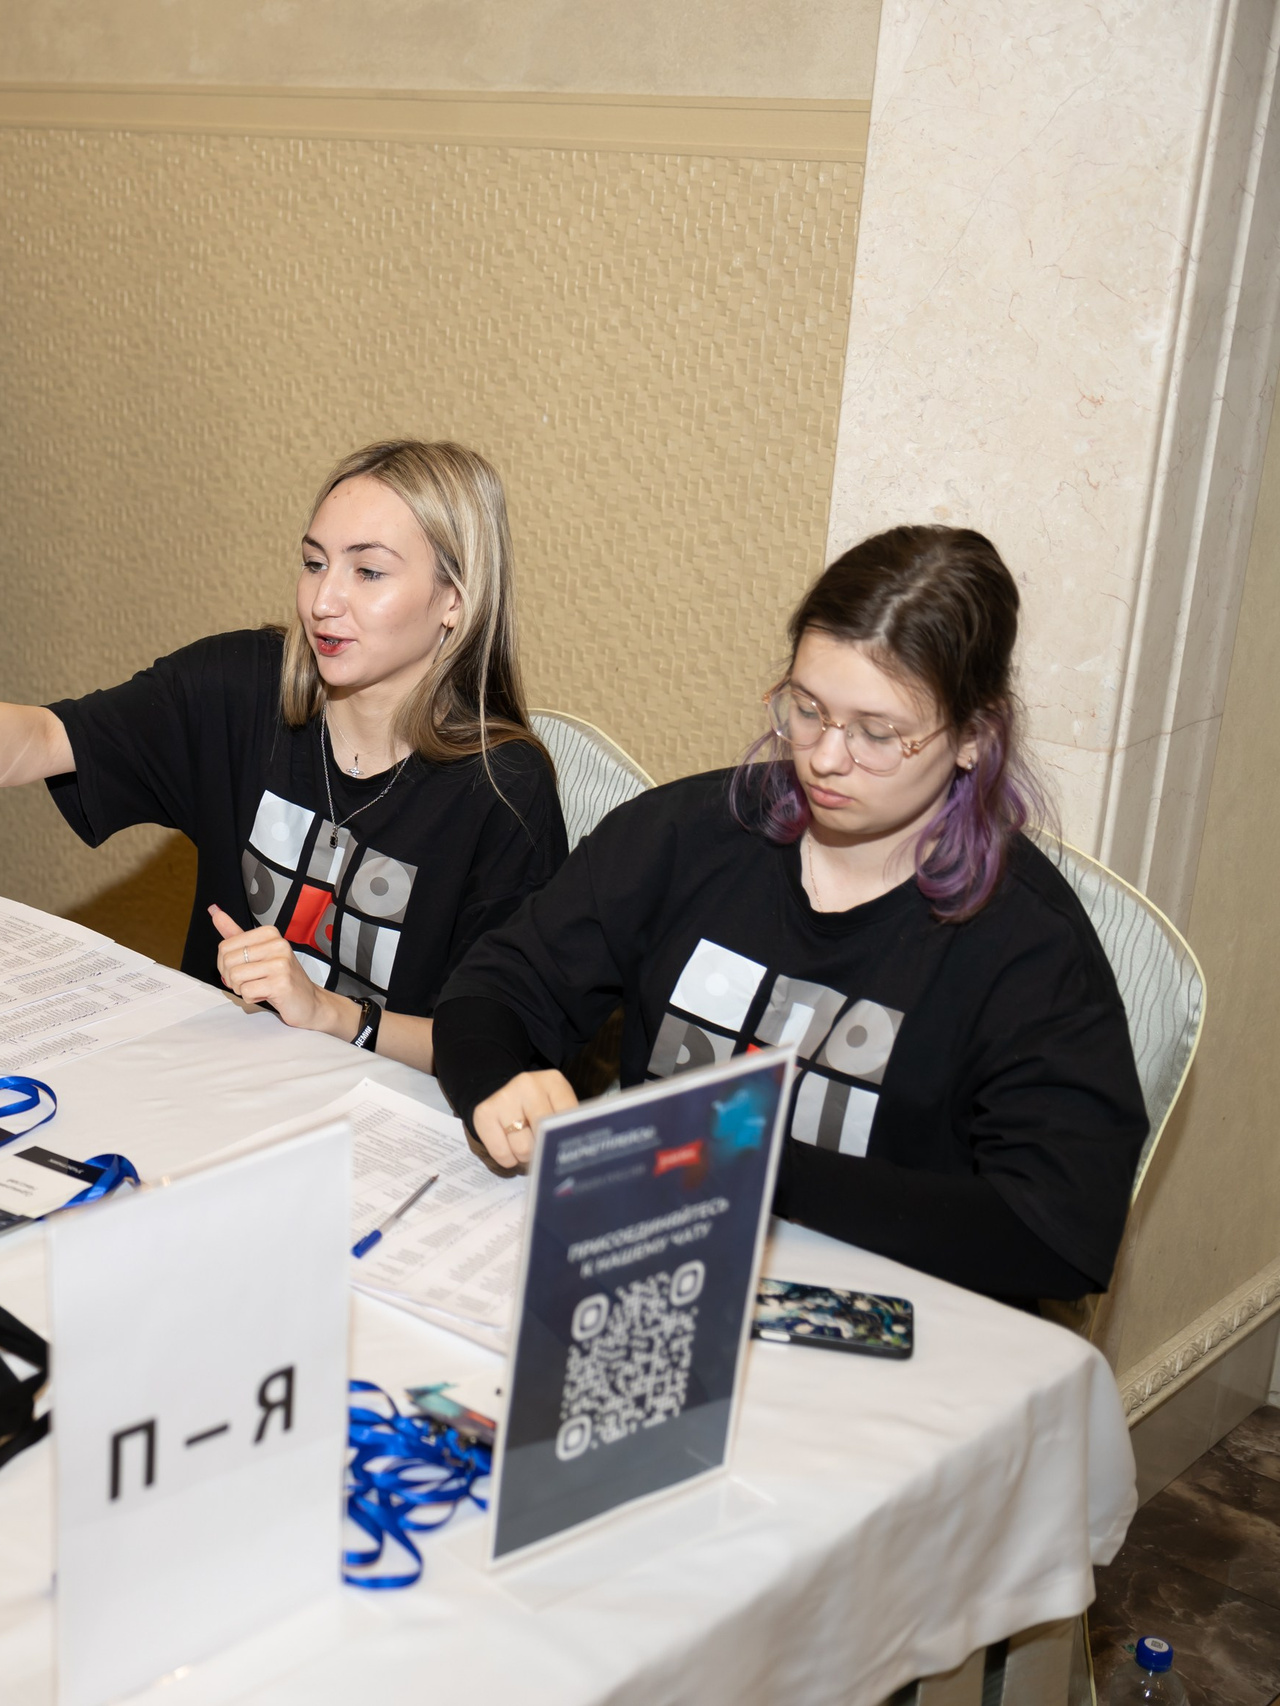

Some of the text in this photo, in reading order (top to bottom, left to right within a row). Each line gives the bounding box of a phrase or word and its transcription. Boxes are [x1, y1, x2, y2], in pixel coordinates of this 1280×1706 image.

[595, 1234, 669, 1273] НАШЕМУ
[110, 1418, 155, 1502] П
[253, 1364, 295, 1445] Я
